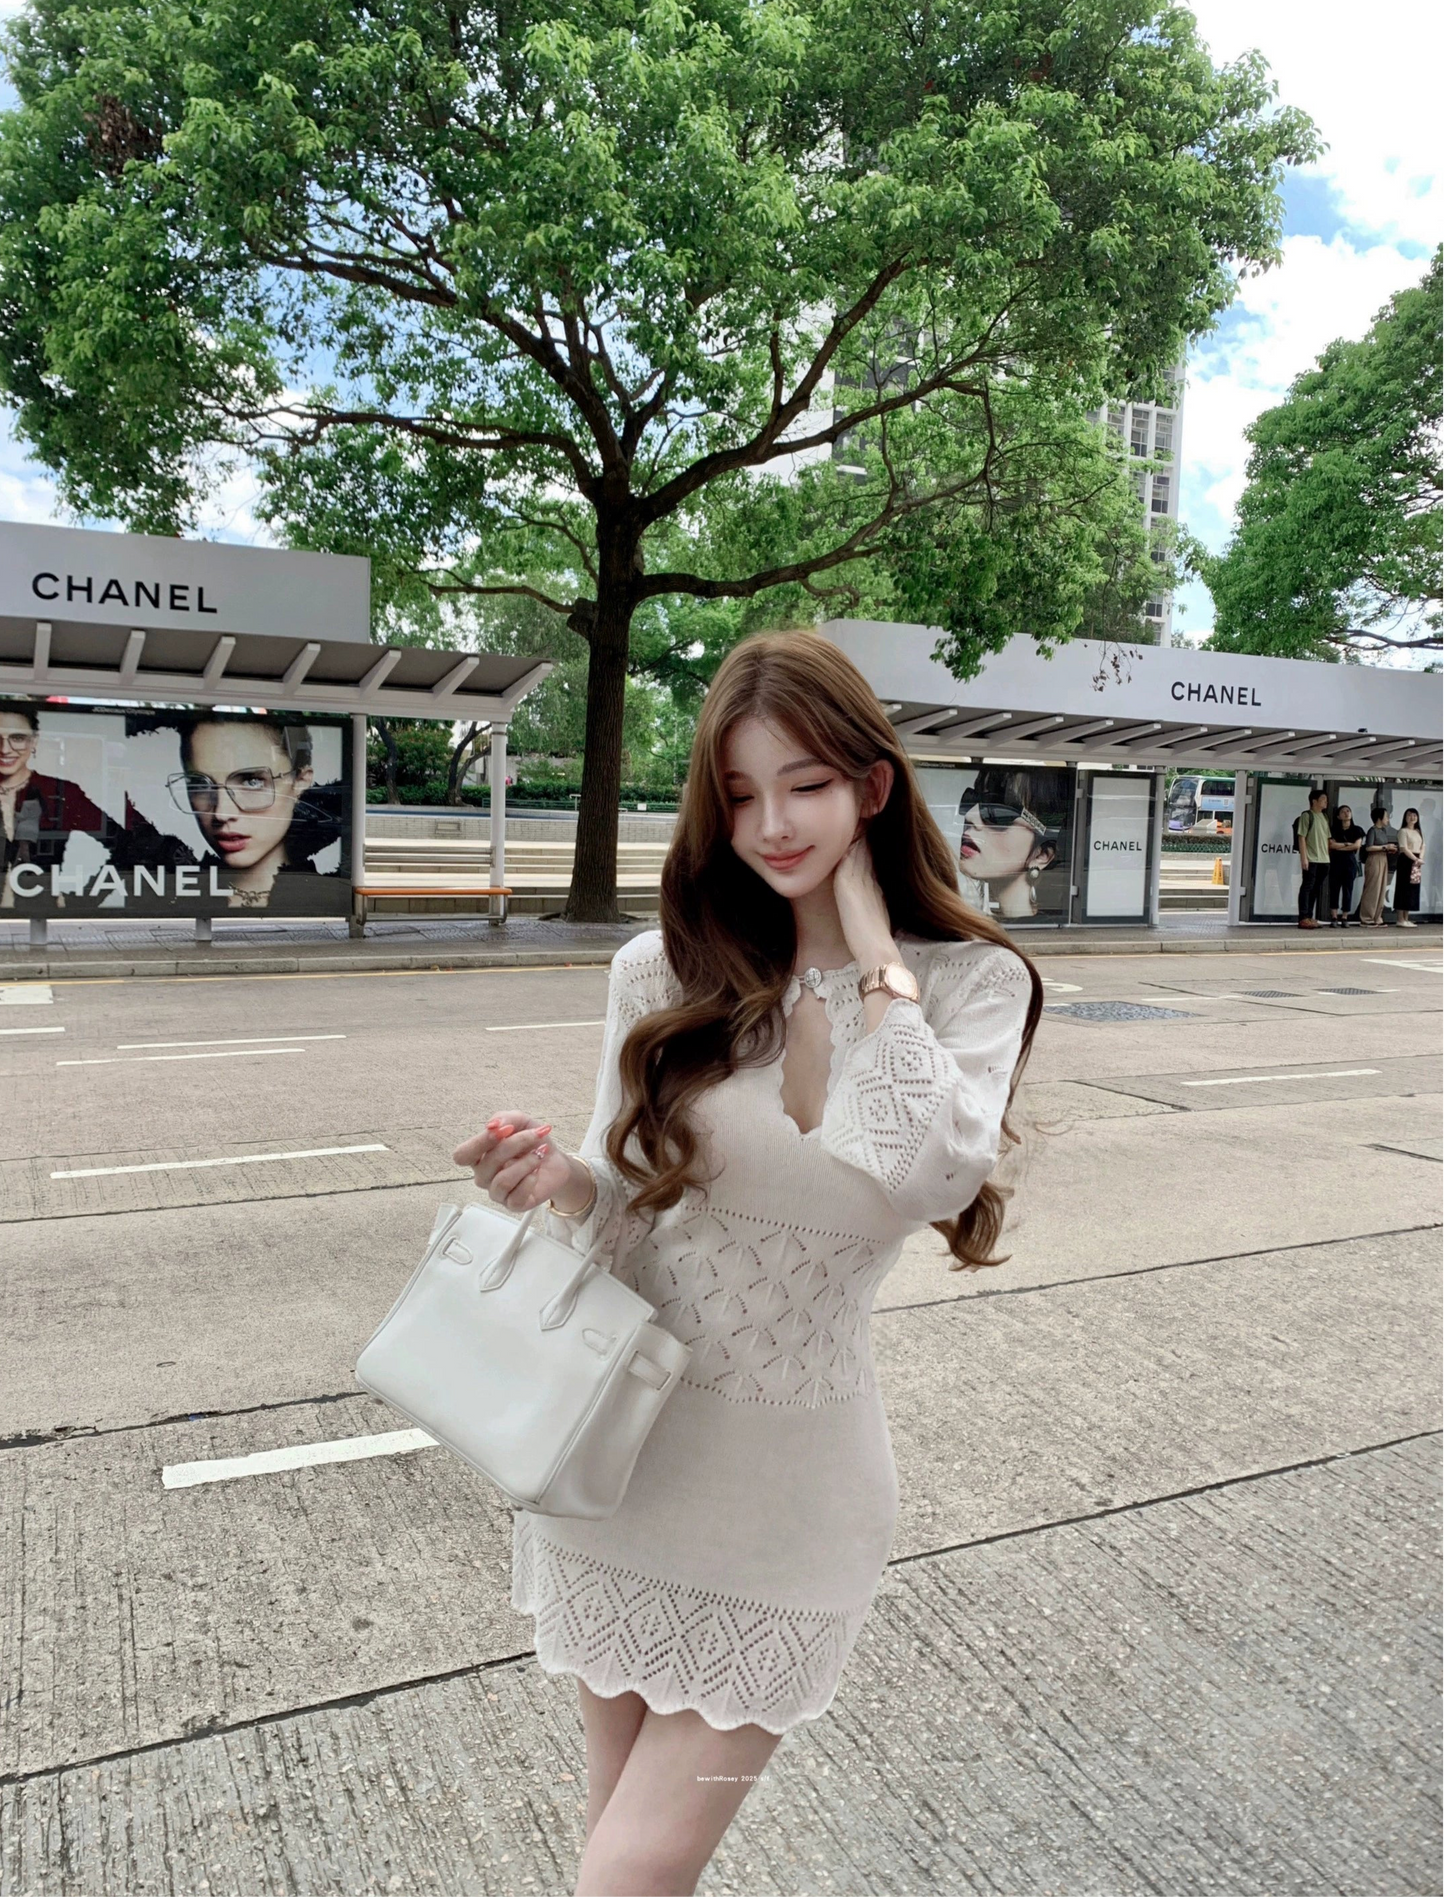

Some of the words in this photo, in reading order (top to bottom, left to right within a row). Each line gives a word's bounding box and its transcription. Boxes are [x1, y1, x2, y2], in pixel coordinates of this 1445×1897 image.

[32, 572, 218, 614] CHANEL
[1171, 681, 1262, 707] CHANEL
[1093, 840, 1142, 851] CHANEL
[9, 863, 235, 898] CHANEL
